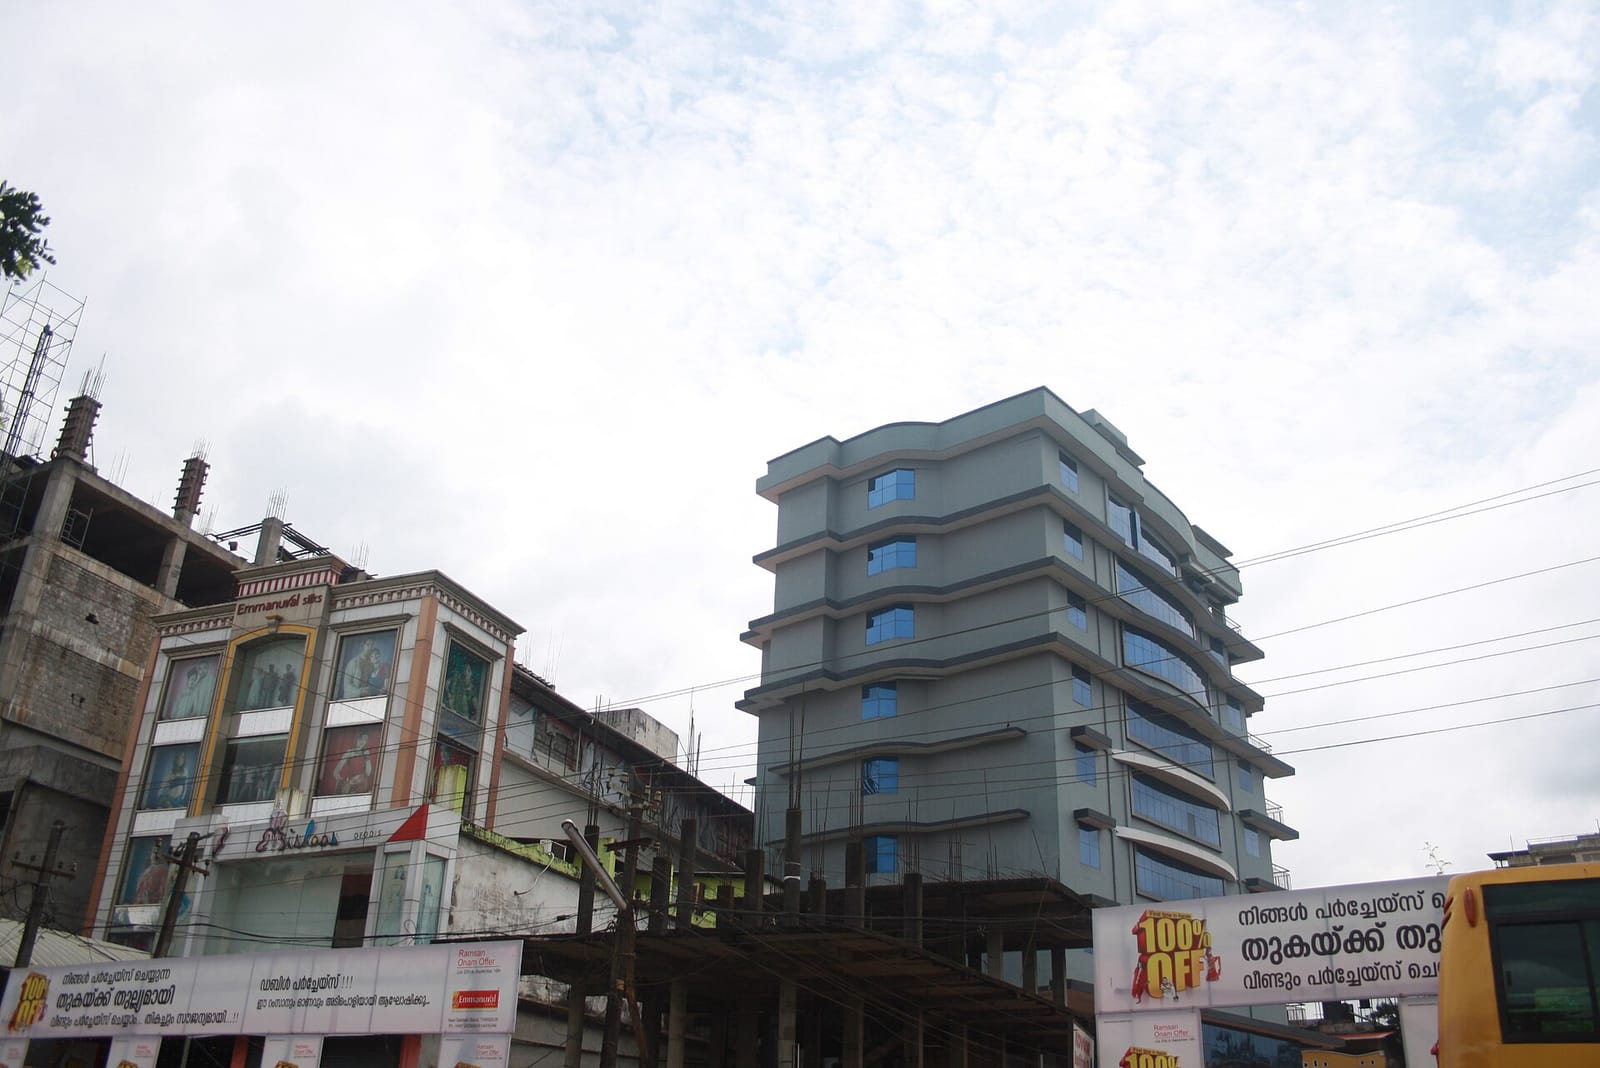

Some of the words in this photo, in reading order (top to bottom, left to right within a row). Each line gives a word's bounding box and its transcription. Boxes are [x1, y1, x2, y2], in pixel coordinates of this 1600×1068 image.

[302, 594, 322, 605] silks
[1238, 903, 1308, 926] നിങ്ങൾ
[1140, 917, 1211, 952] 100%
[1241, 921, 1387, 965] തുകയ്ക്ക്
[479, 958, 495, 966] Offer
[1147, 949, 1205, 998] OFF
[1243, 970, 1301, 991] വീണ്ടും
